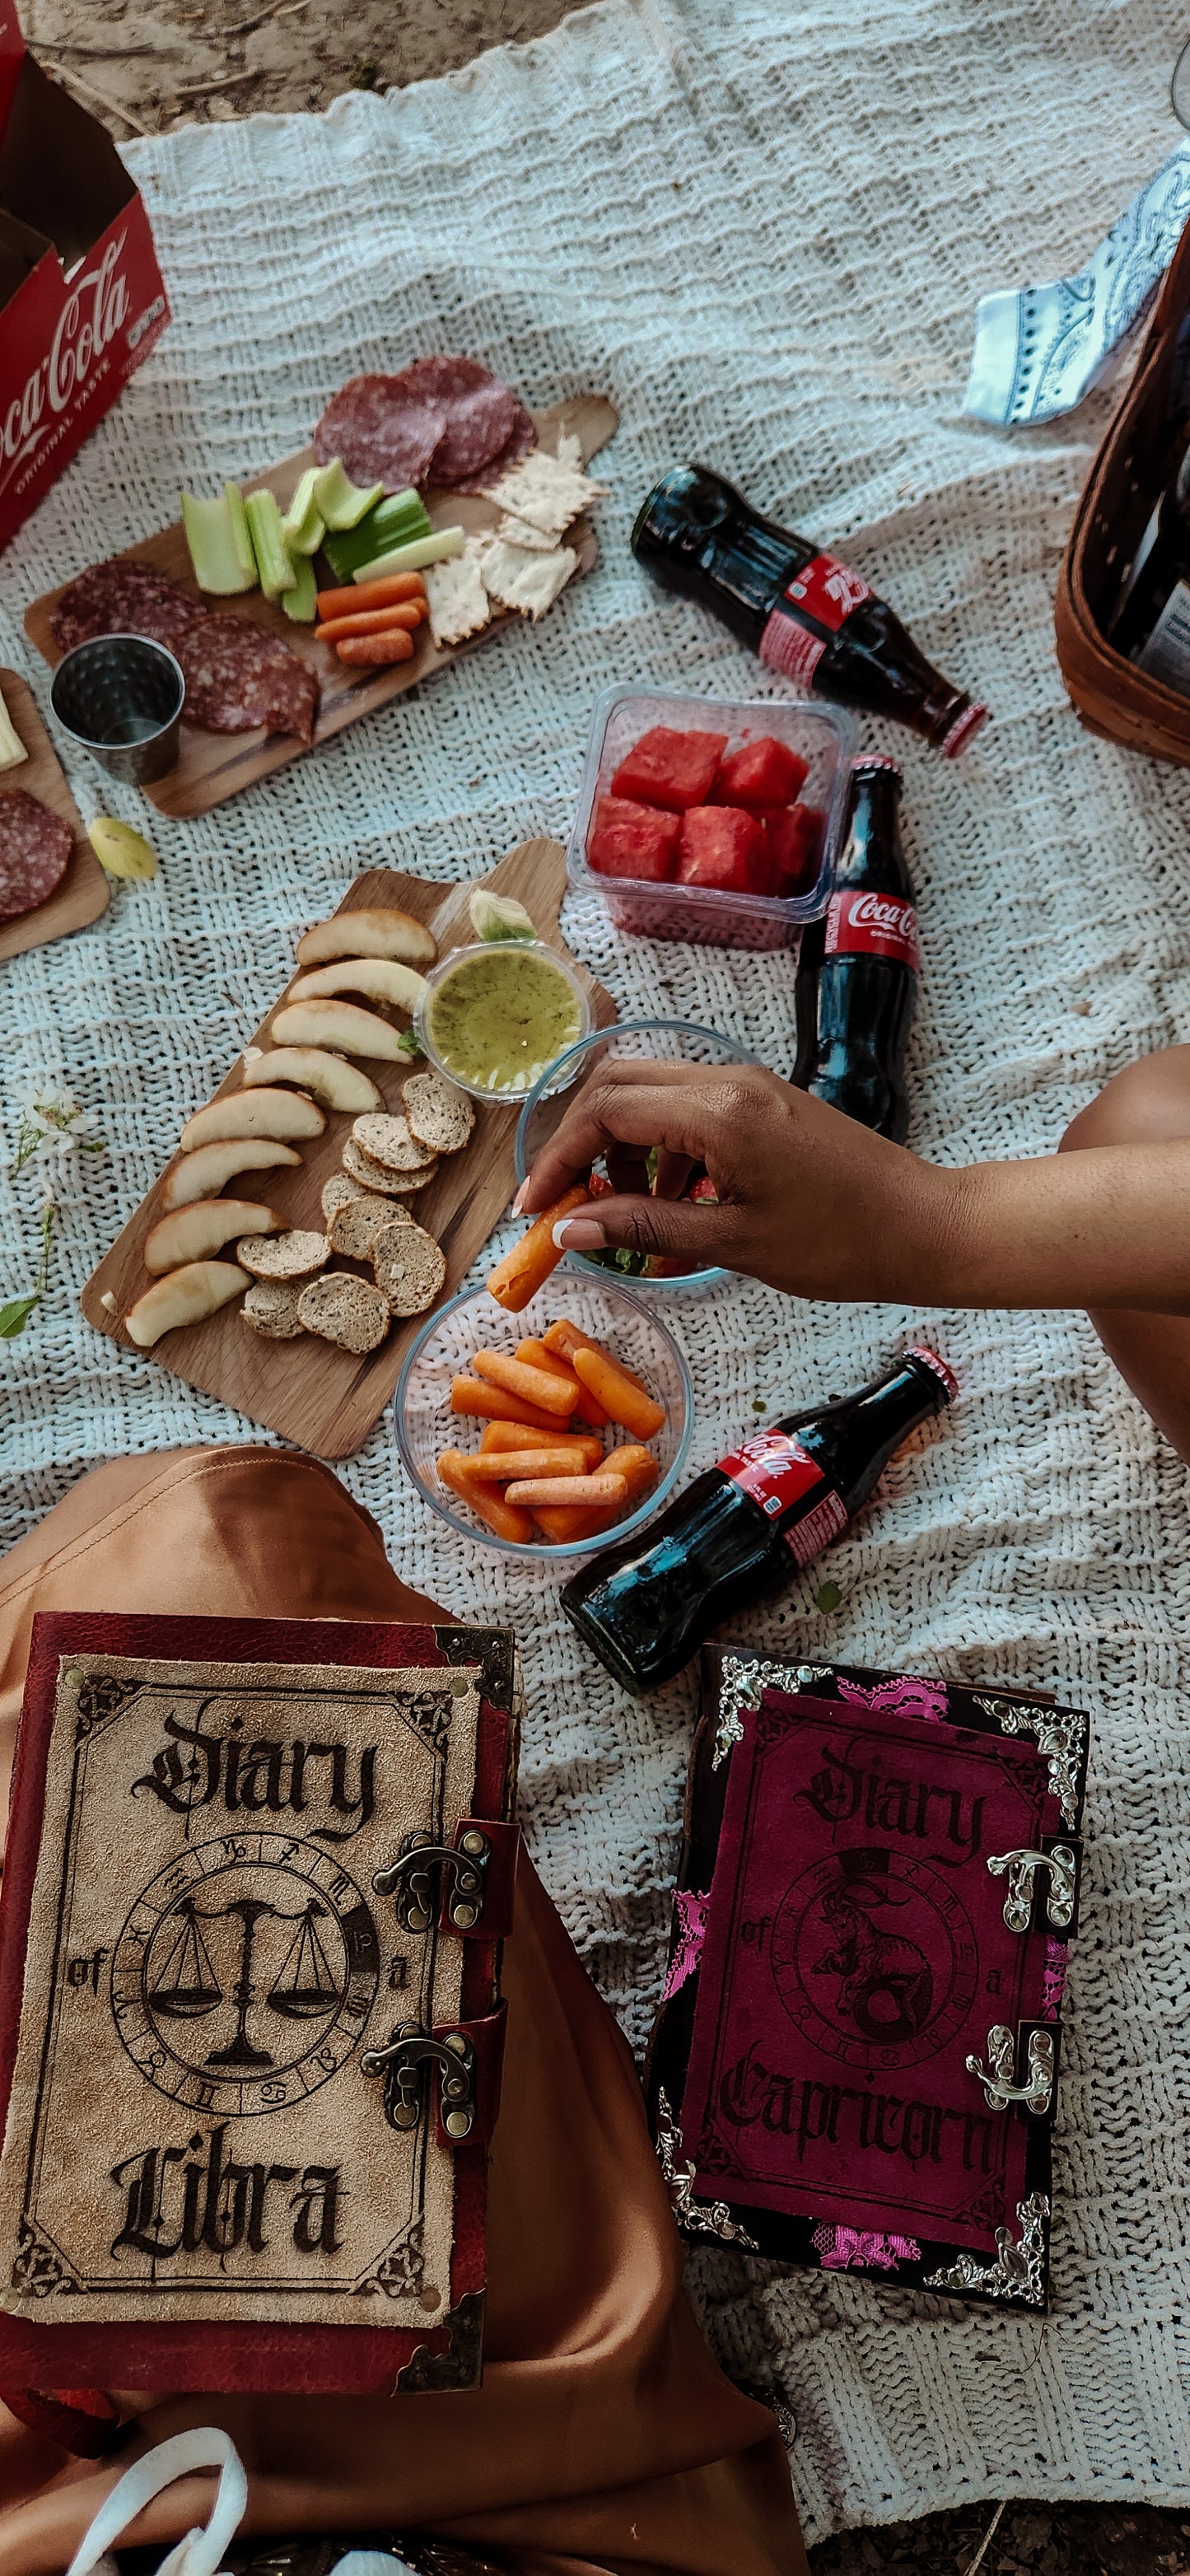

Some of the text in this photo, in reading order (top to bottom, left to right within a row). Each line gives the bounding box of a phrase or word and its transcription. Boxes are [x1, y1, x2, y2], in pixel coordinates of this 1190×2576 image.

[0, 226, 129, 492] ca-Cola
[15, 357, 111, 494] ORIGINAL TASTE
[131, 1696, 377, 1843] Diary
[793, 1736, 987, 1869] Diary
[66, 1947, 412, 1997] of a
[742, 1916, 1002, 1995] of a
[721, 2040, 995, 2175] Capricorn
[110, 2121, 351, 2284] Libra
